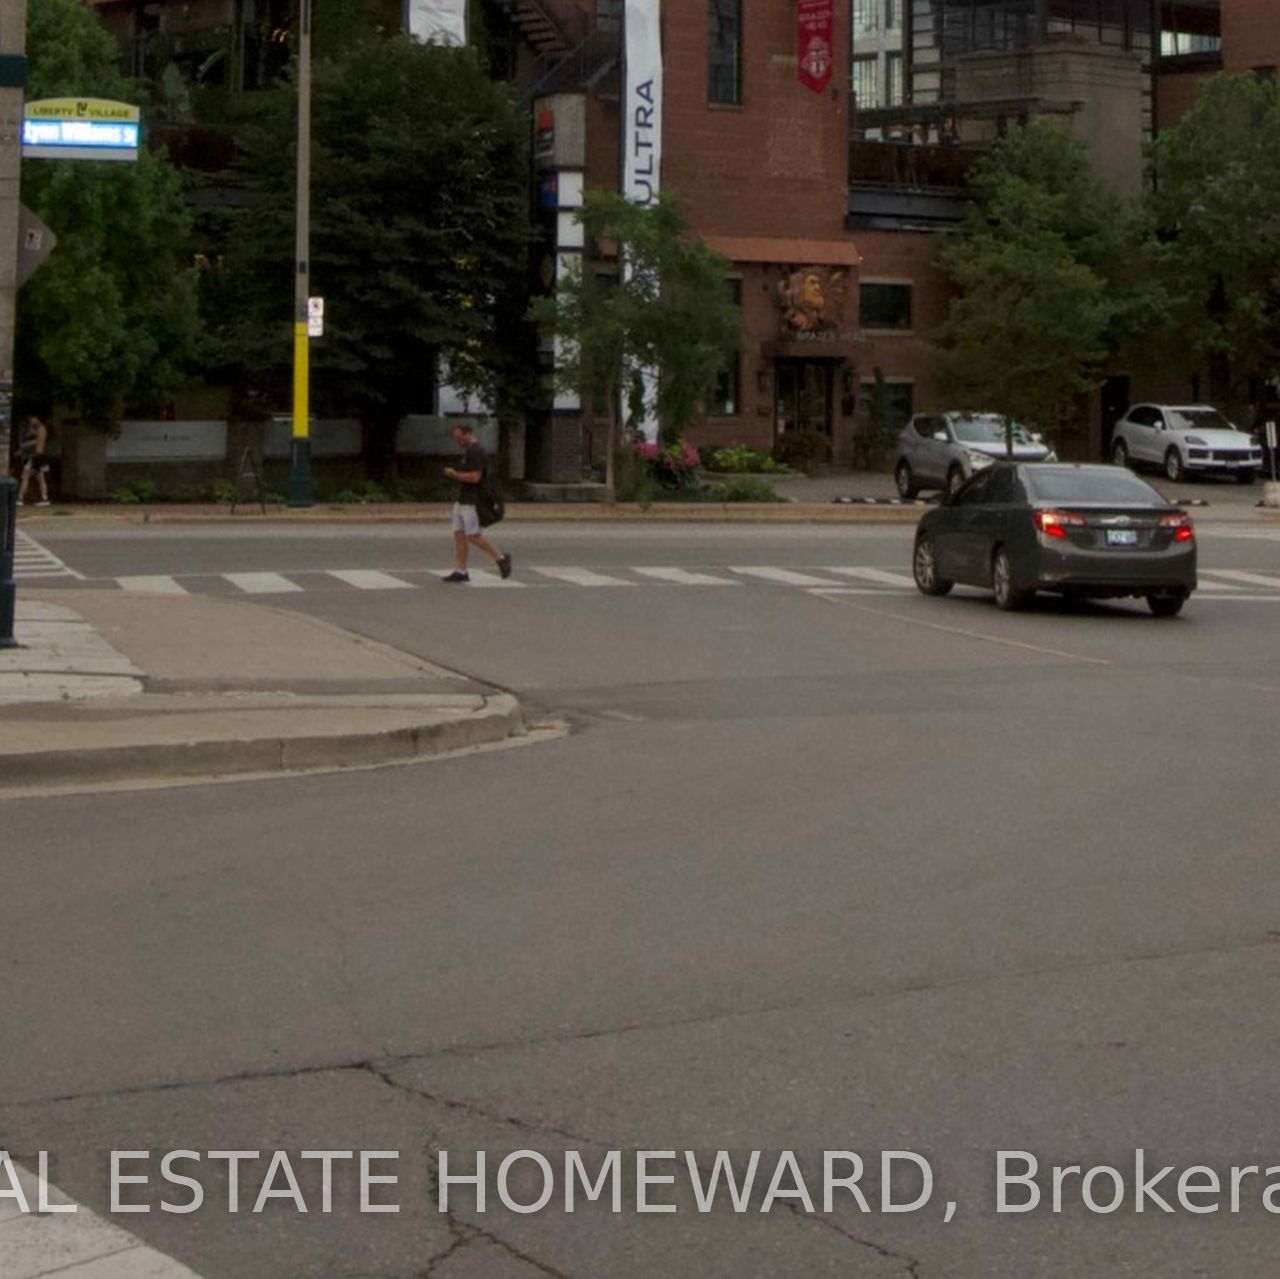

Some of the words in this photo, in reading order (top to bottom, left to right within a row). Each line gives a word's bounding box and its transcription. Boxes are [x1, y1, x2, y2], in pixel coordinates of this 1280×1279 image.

[34, 106, 73, 116] LIBERTY
[90, 107, 129, 118] VILLAGE
[634, 79, 655, 205] ULTRA
